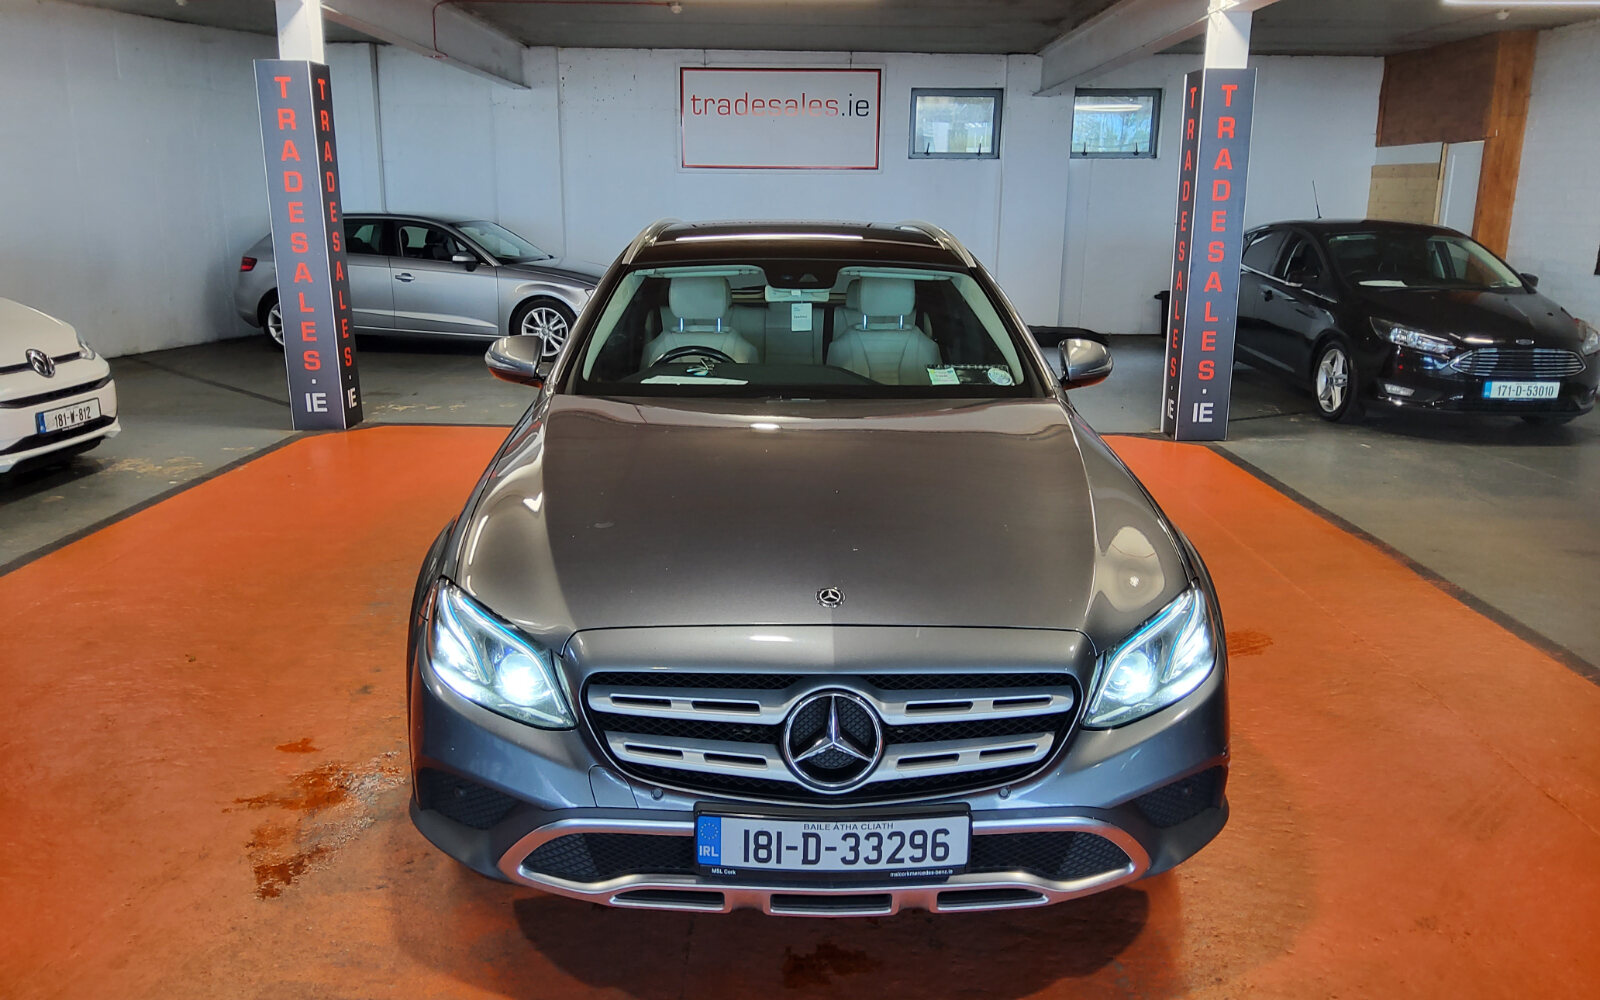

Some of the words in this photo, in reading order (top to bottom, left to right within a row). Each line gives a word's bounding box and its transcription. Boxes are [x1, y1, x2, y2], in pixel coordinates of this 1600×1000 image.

[690, 91, 870, 117] tradesales.ie
[1498, 384, 1554, 397] 171-D-53010
[55, 406, 91, 428] 181-W-812
[803, 823, 830, 831] BAILE
[860, 822, 894, 831] CLIATH
[699, 845, 719, 858] IRL
[743, 828, 950, 865] 181-D-33296
